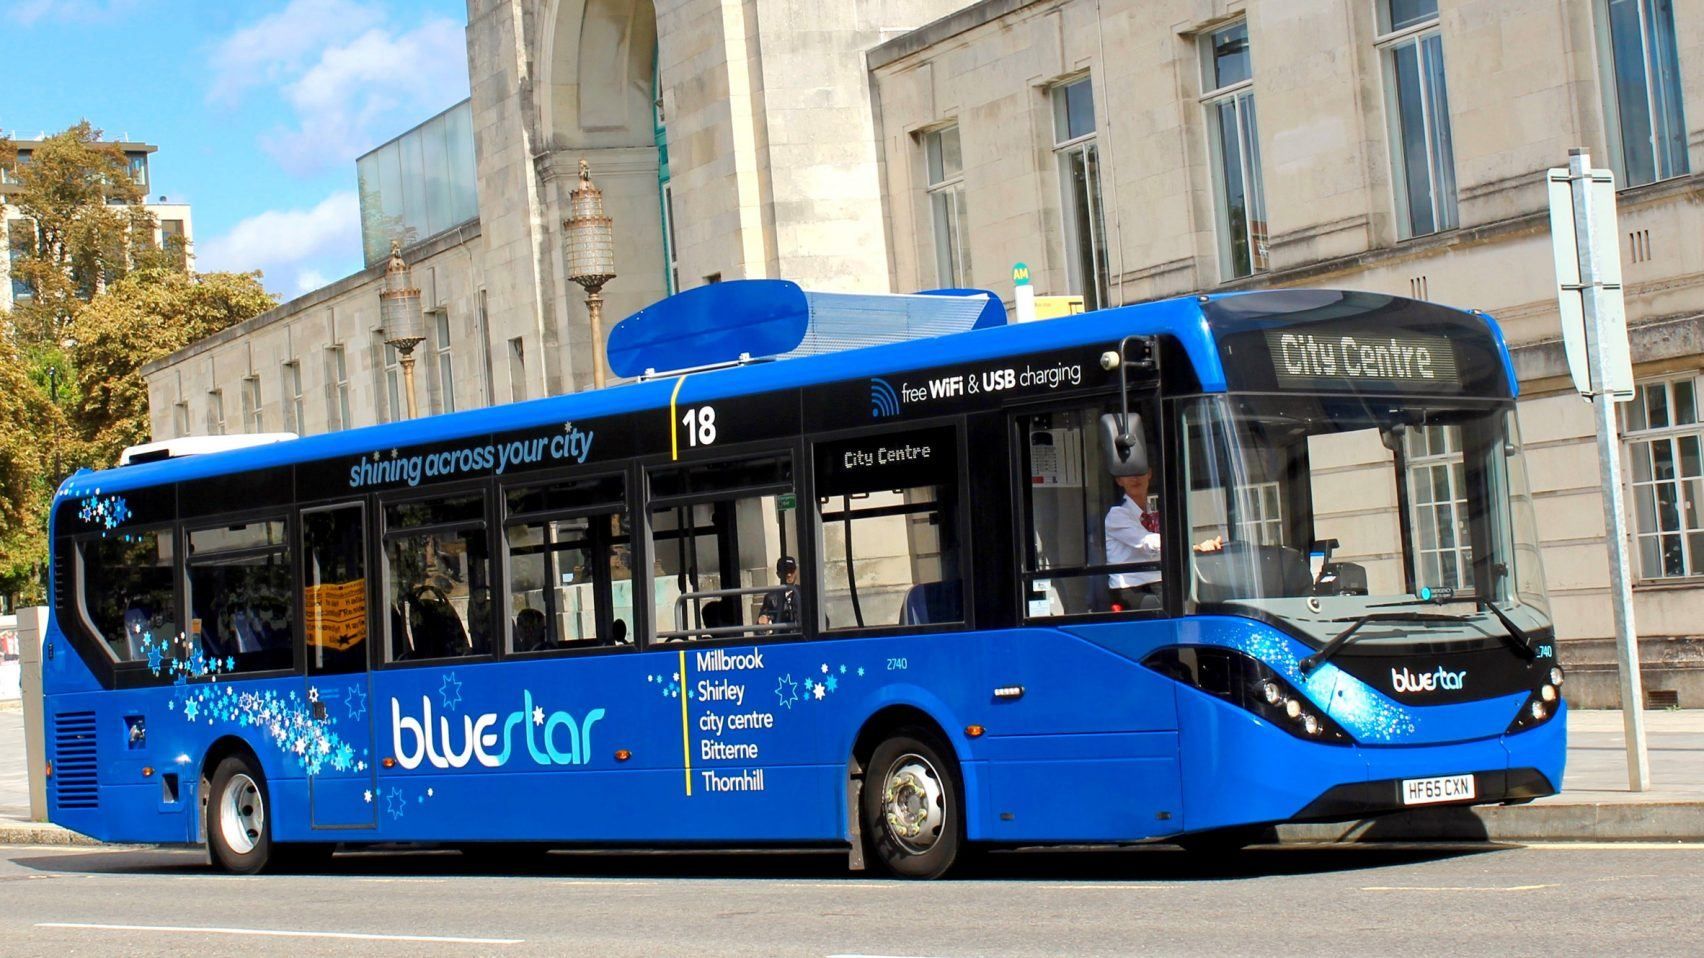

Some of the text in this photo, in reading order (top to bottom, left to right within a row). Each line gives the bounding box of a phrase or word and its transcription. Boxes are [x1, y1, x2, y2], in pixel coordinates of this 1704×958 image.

[1013, 267, 1029, 280] AM
[1281, 334, 1434, 378] City Centre
[902, 362, 1081, 404] free WiFi & USB charging
[682, 406, 717, 447] 18
[350, 421, 594, 487] shining across your city
[844, 444, 932, 469] City Centre
[696, 646, 764, 672] Millbrook
[886, 657, 908, 671] 2740
[1391, 665, 1467, 692] bluestar
[697, 678, 745, 706] Shirley
[391, 689, 605, 770] bluestar
[699, 710, 773, 736] city centre
[701, 739, 758, 760] Bitterne
[701, 768, 764, 792] Thornhill
[1408, 777, 1469, 799] HF65 CXN
